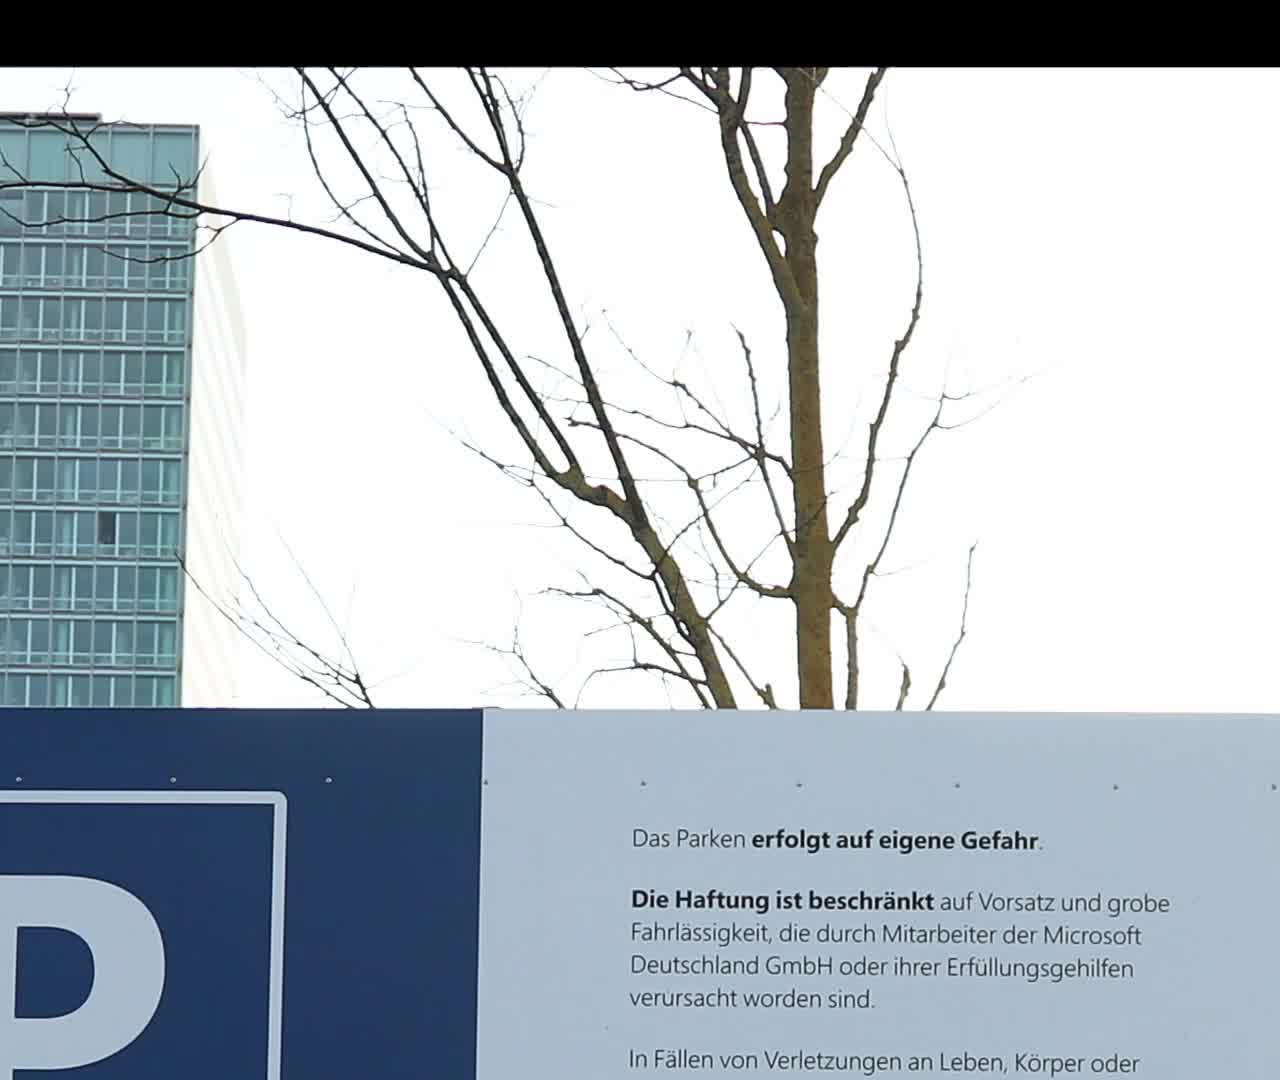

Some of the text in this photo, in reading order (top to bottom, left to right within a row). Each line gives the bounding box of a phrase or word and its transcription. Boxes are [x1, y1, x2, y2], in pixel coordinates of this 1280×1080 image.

[632, 827, 1044, 855] Das Parken erfolgt auf eigene Gefahr.
[631, 888, 1171, 918] Die Haftung ist beschränkt auf Vorsatz und grobe
[631, 920, 1143, 948] Fahrlässigkeit, die durch Mitarbeiter der Microsoft
[631, 953, 1134, 984] Deutschland GmbH oder ihrer Erfüllungsgehilfen
[629, 987, 876, 1009] verursacht worden sind.
[629, 1048, 1141, 1079] In Fällen von Verletzungen an Leben, Körper oder
